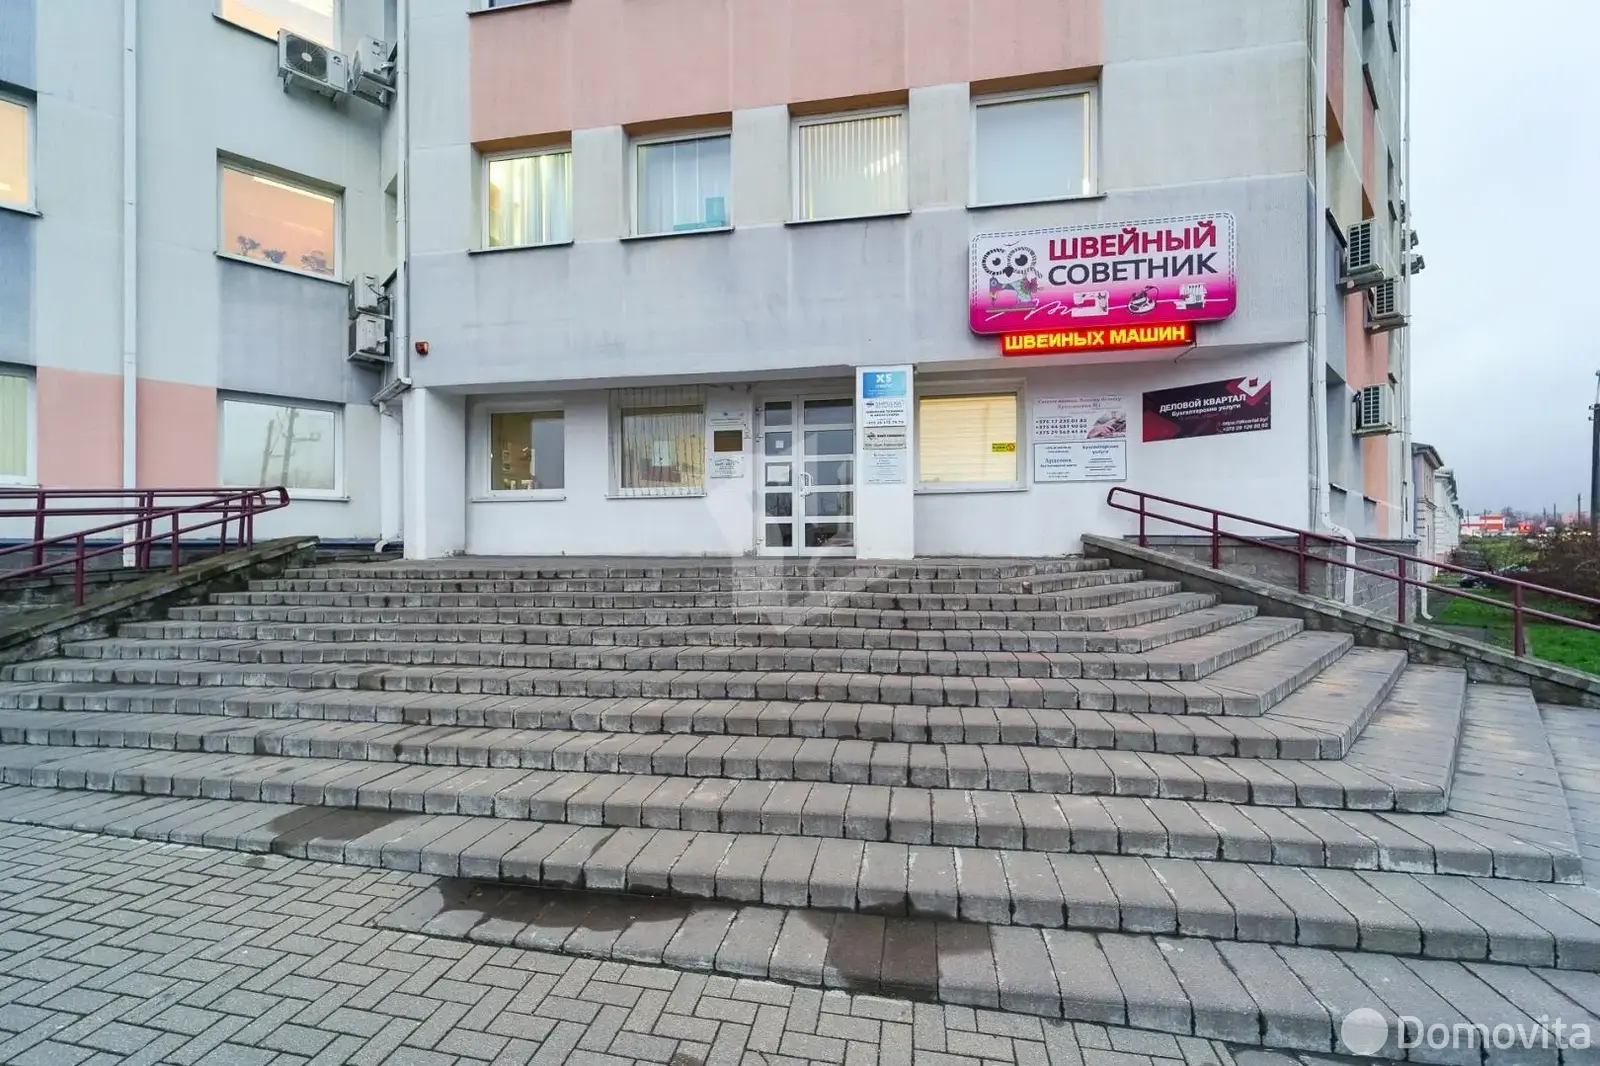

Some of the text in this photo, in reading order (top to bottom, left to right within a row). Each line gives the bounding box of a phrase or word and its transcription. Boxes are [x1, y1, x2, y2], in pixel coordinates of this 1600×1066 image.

[1049, 220, 1217, 261] ШВЕЙНЫЙ
[1048, 252, 1219, 286] СОВЕТНИК
[1110, 326, 1186, 345] МАШИН
[1159, 394, 1247, 413] ДЕЛОВОЙ КВАРТАЛ
[1218, 404, 1242, 412] услуги
